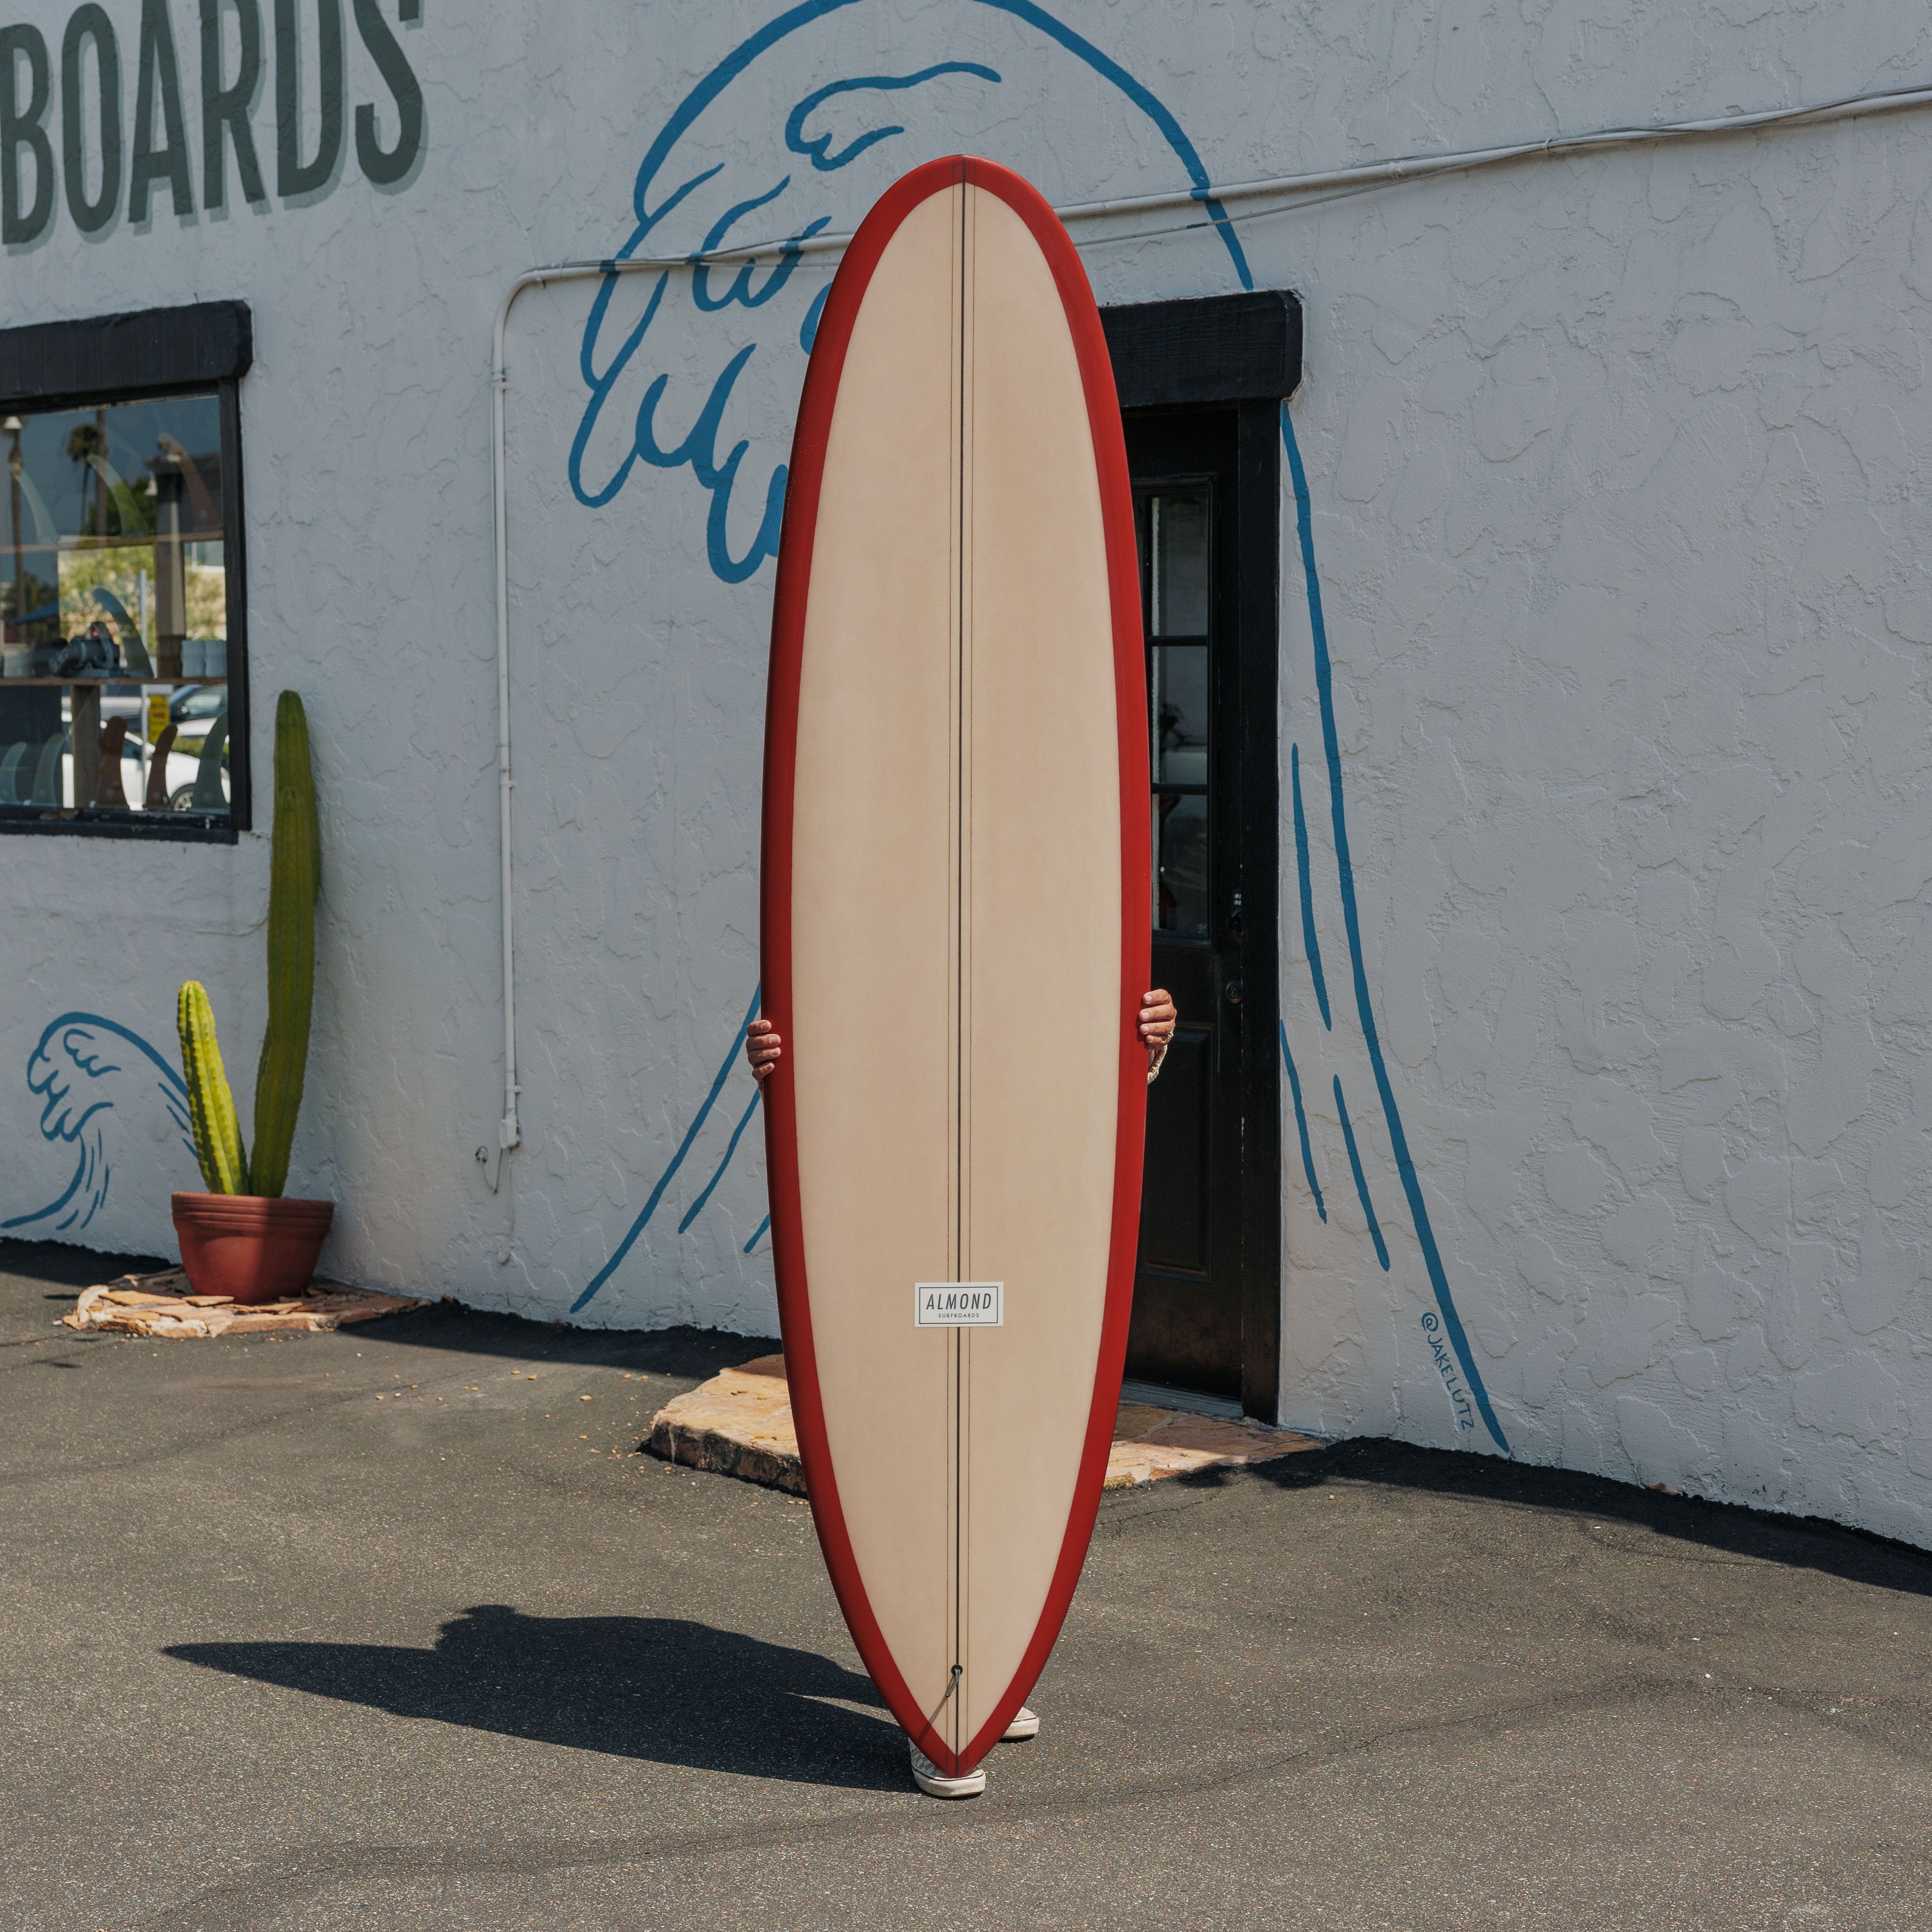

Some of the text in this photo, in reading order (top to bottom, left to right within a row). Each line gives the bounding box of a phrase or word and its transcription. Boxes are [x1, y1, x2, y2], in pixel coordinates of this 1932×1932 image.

[0, 0, 427, 254] BOARDS
[926, 1293, 991, 1310] ALMOND
[1421, 1312, 1475, 1430] @JAKELUTZ
